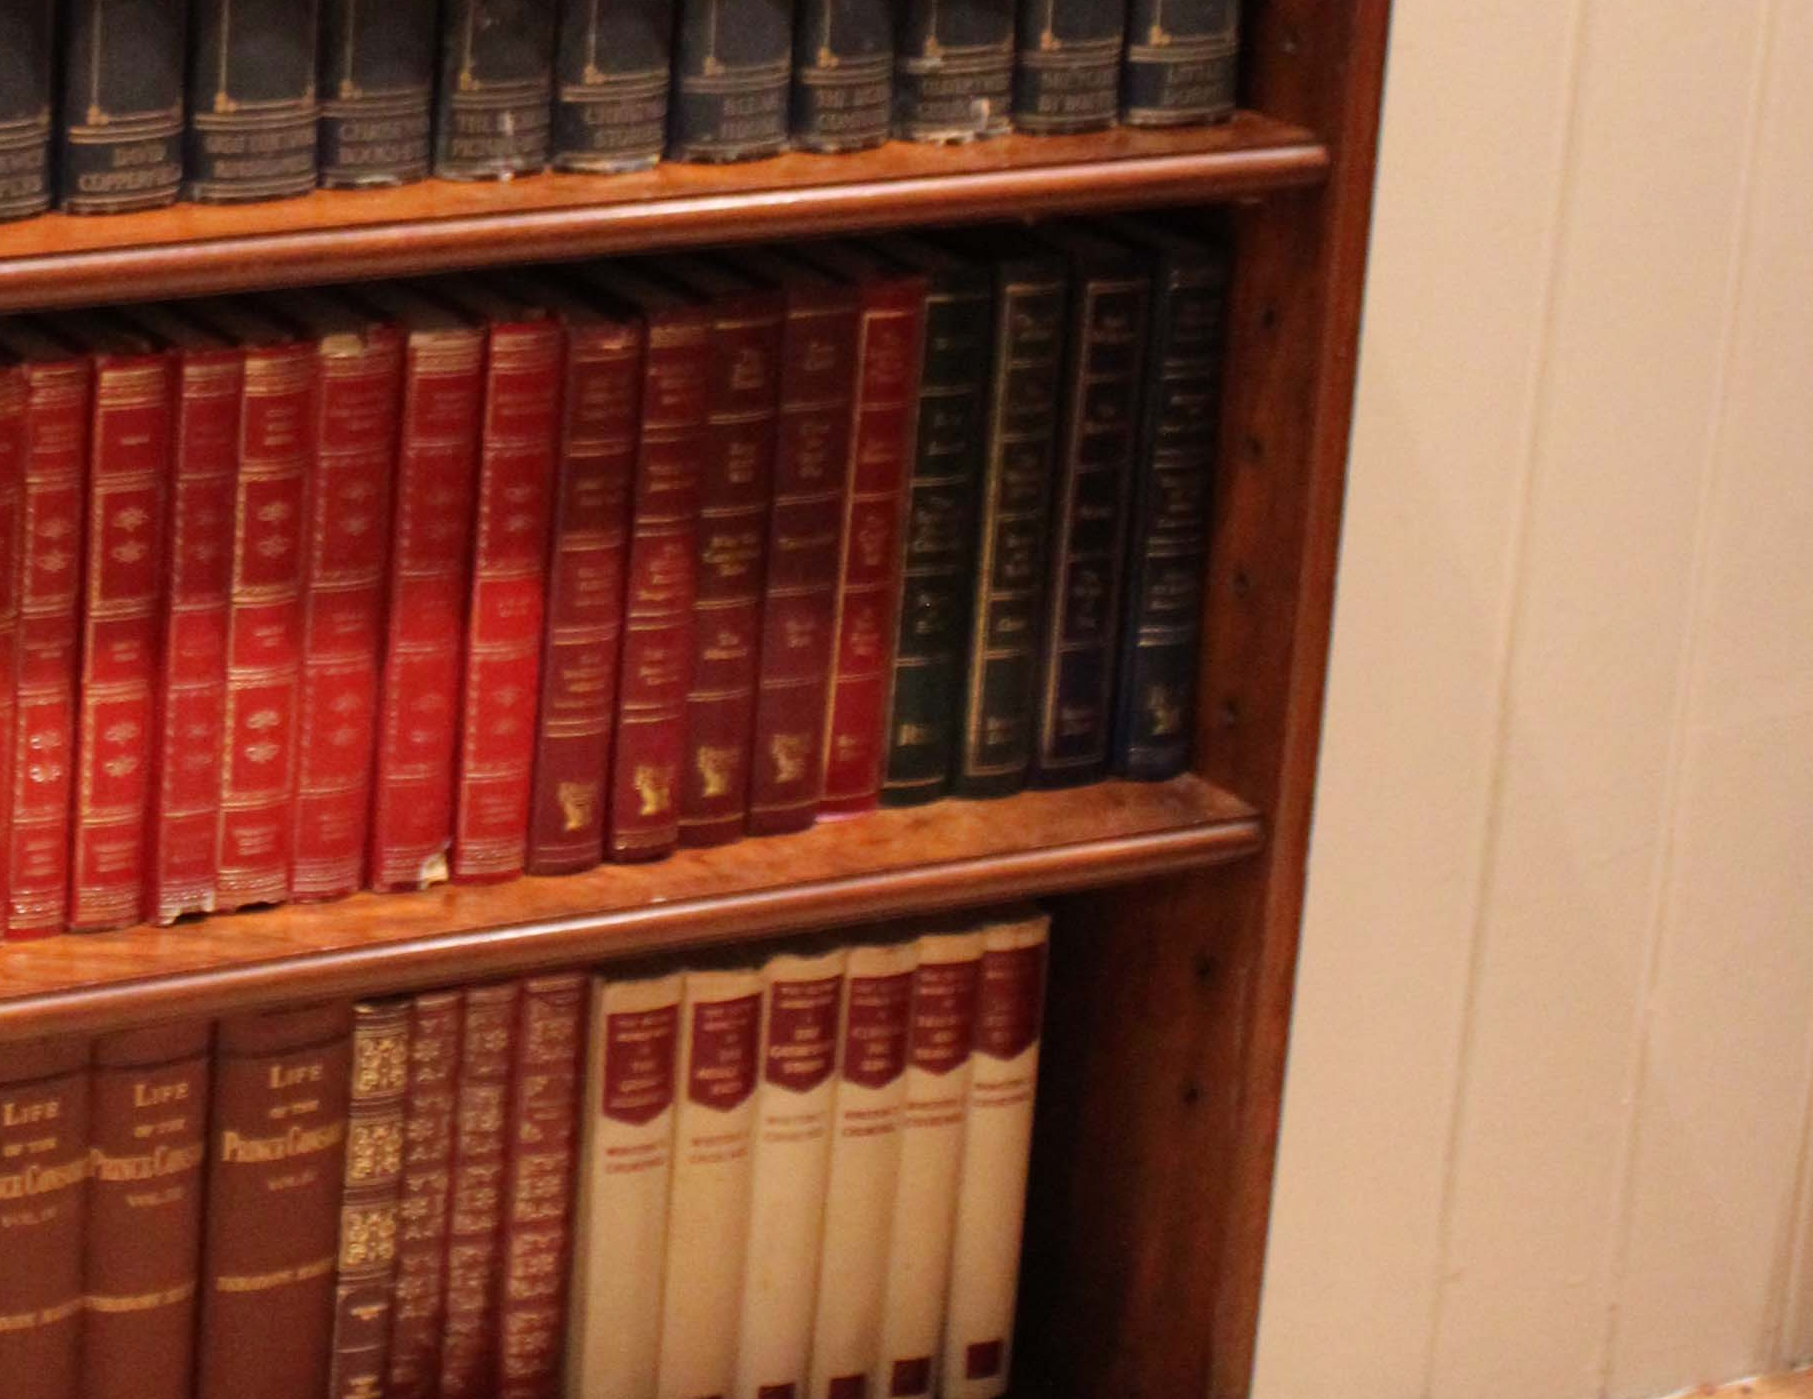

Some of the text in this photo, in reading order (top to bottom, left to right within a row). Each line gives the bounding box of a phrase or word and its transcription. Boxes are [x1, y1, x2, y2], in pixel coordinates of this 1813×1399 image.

[270, 1064, 324, 1090] LIFE
[134, 1082, 189, 1108] LIFE
[3, 1101, 60, 1127] LIFE
